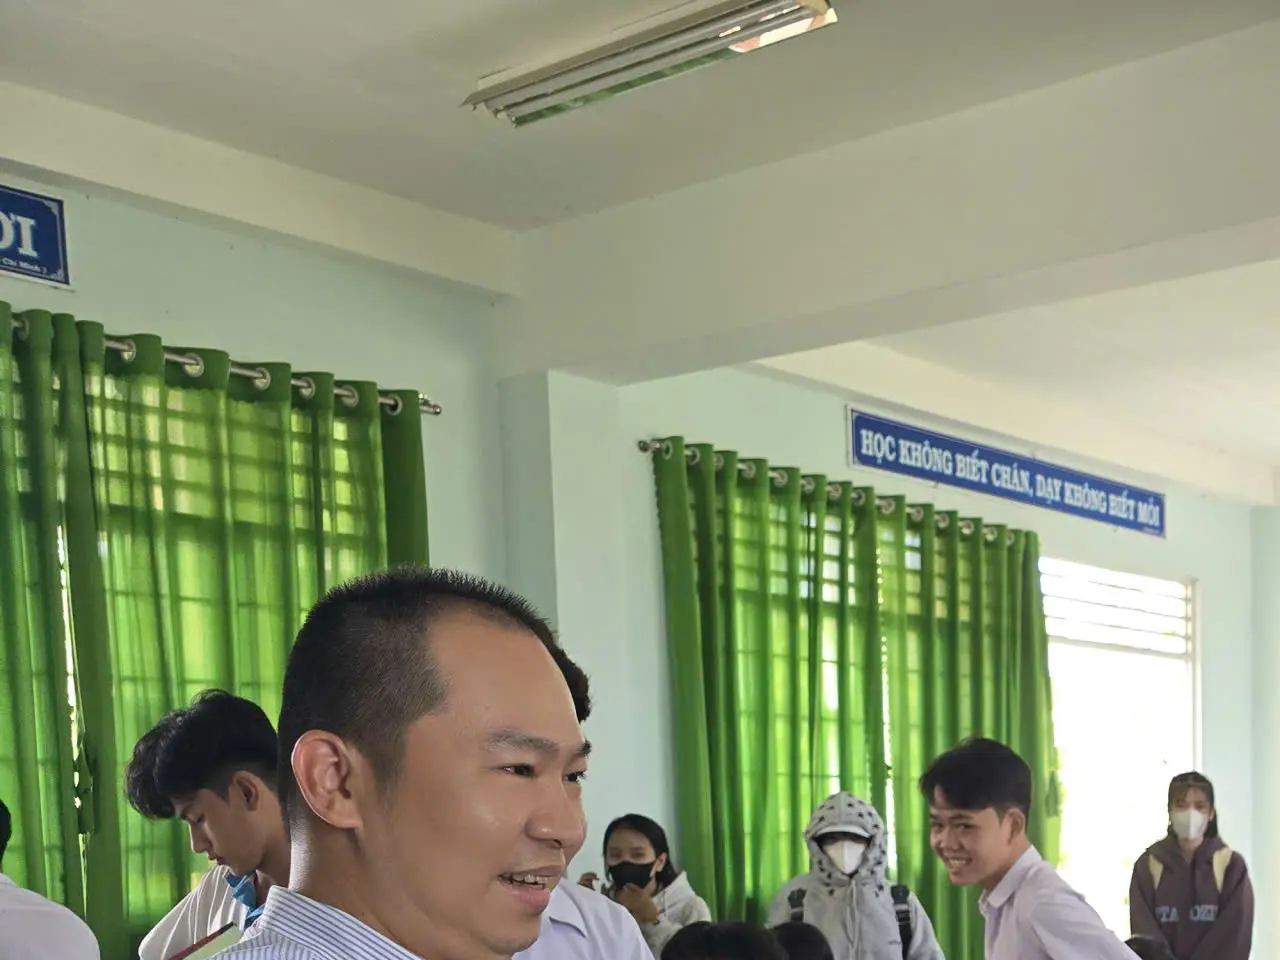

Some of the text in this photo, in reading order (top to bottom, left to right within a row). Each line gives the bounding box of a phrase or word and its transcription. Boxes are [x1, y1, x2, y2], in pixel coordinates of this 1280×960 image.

[860, 429, 896, 464] HỌC
[898, 439, 953, 475] KHÔNG
[955, 449, 989, 483] BIẾT
[1035, 473, 1062, 504] DẠY
[1063, 481, 1107, 514] KHÔNG
[1108, 489, 1135, 520] BIẾT
